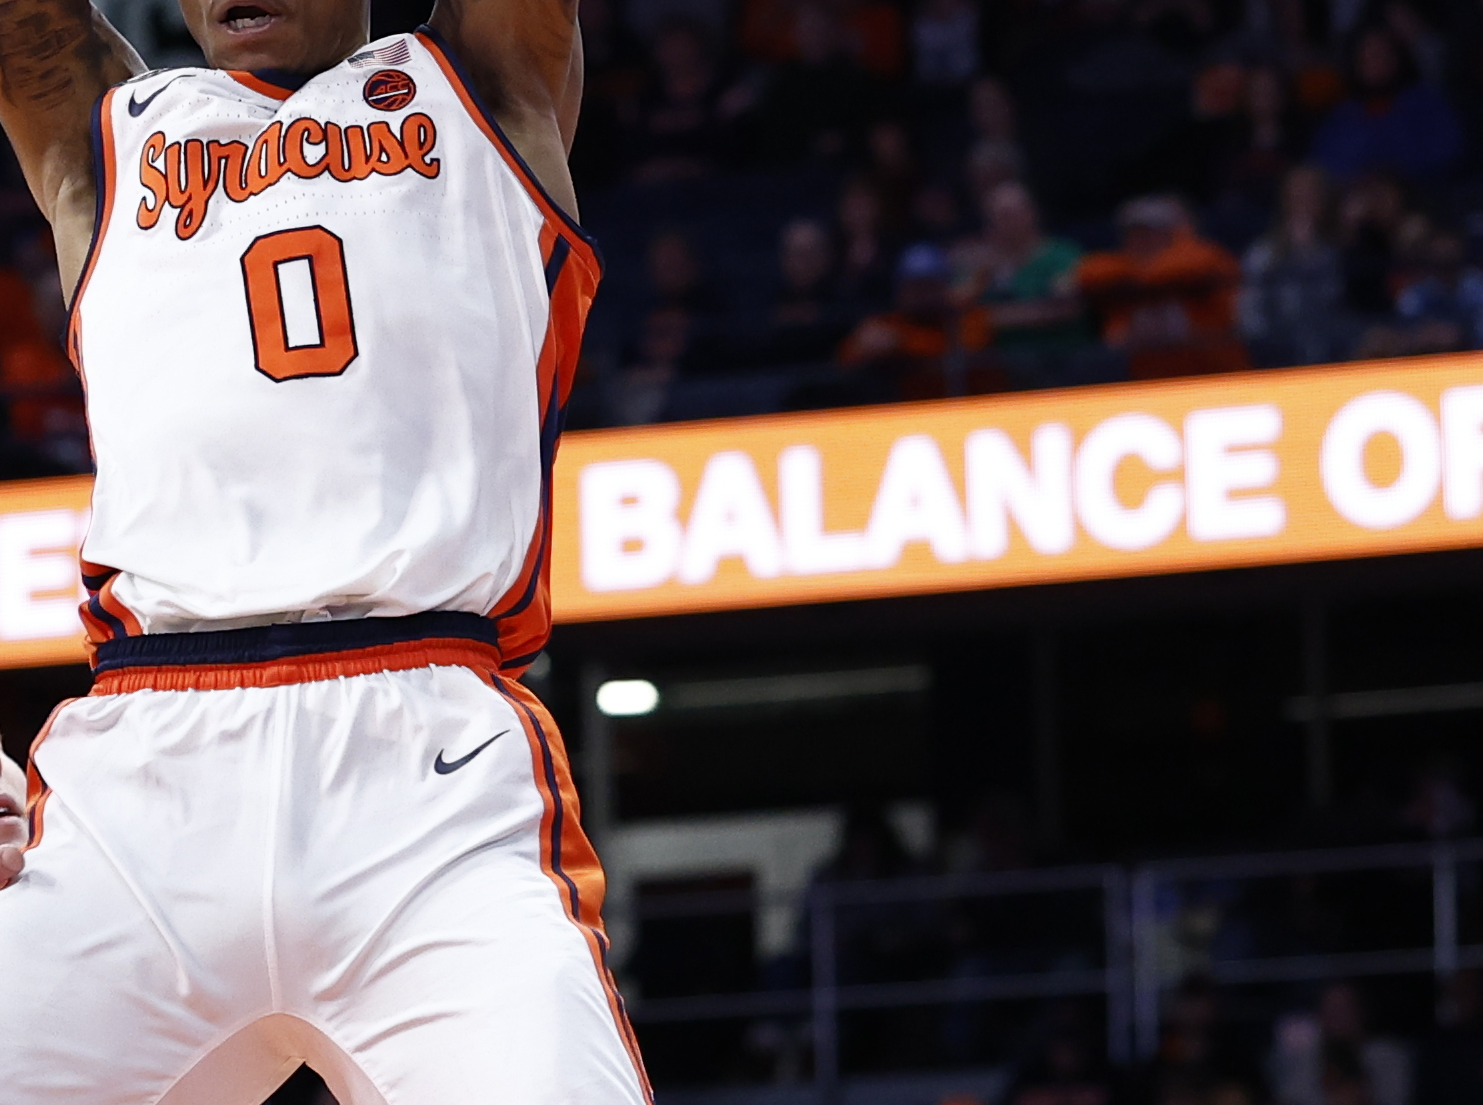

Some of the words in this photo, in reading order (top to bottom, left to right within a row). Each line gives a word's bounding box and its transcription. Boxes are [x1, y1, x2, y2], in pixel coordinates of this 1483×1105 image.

[373, 80, 411, 96] ACC
[135, 111, 441, 241] Syracuse
[239, 224, 360, 384] 0
[576, 402, 1288, 594] BALANCE
